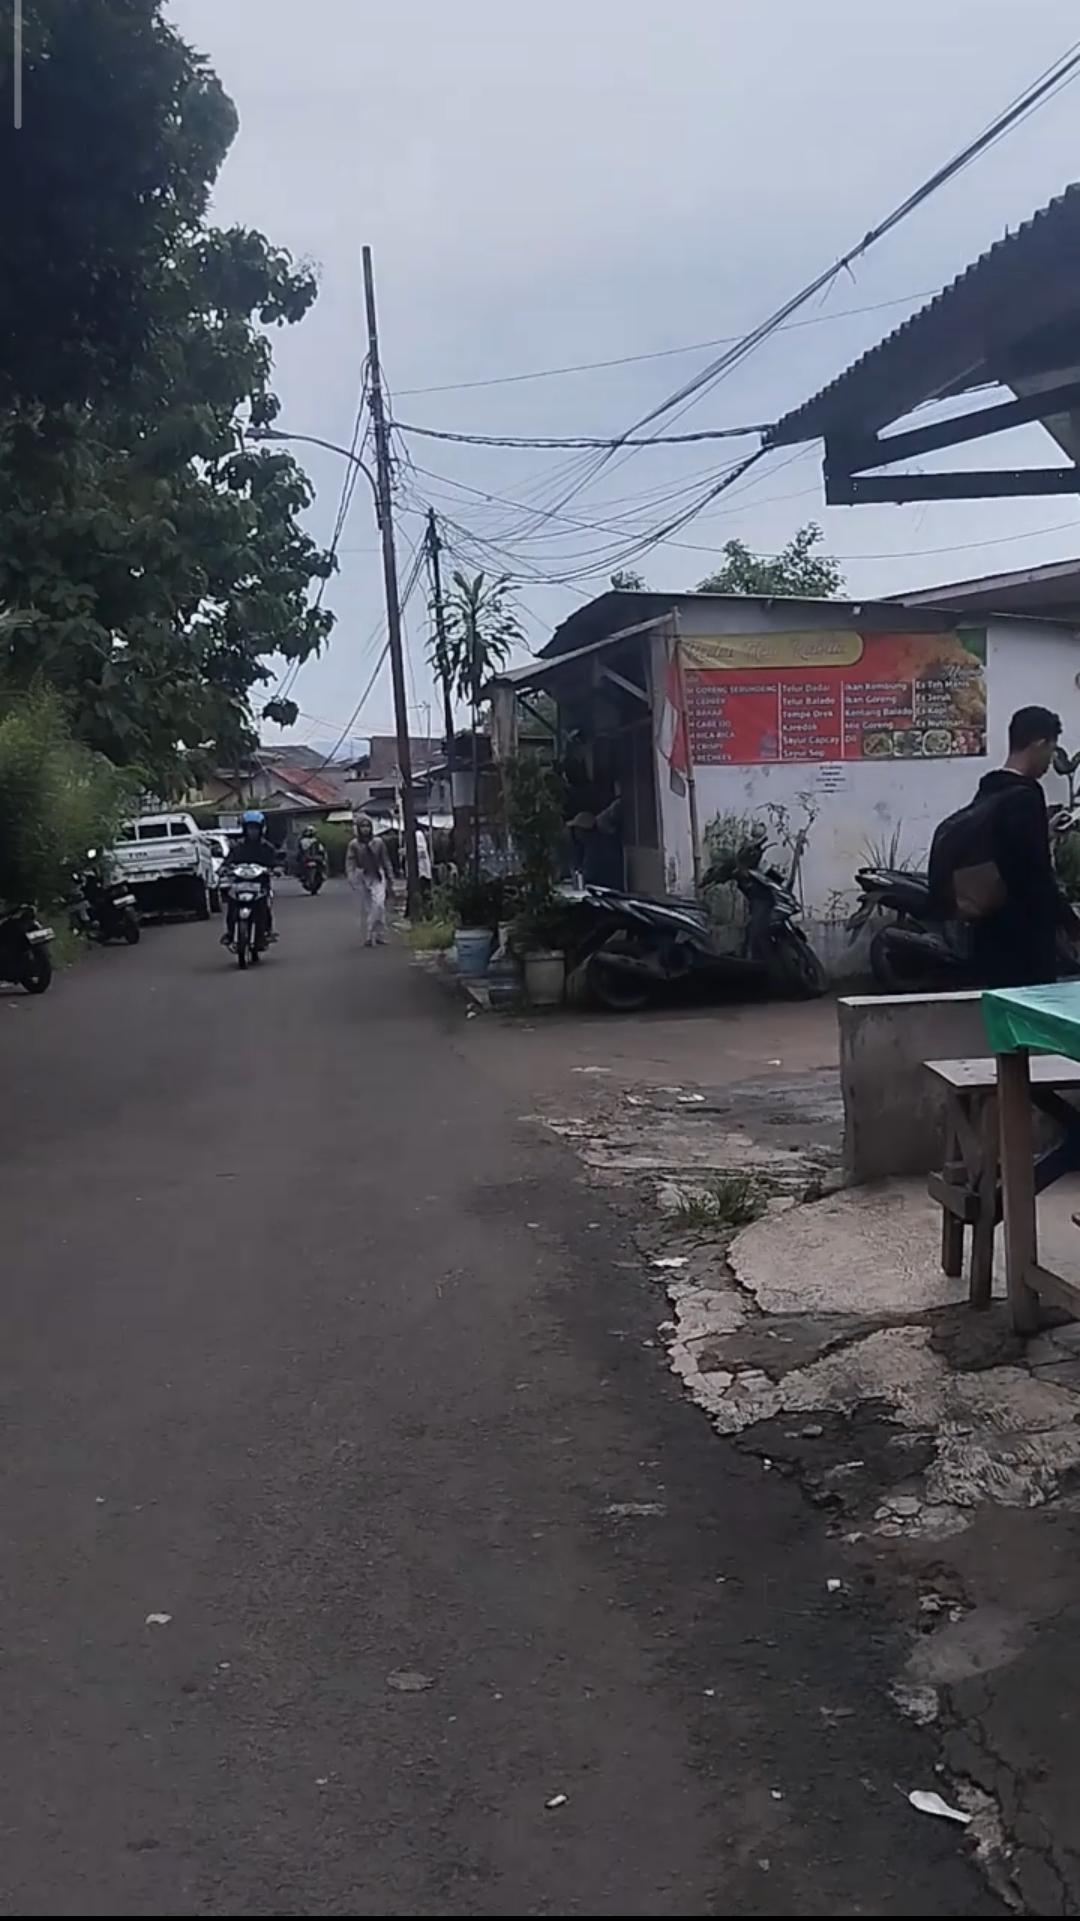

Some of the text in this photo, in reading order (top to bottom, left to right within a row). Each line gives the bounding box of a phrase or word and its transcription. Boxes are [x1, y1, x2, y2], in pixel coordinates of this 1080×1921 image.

[783, 684, 830, 693] Telur Dadar
[845, 682, 863, 690] Ikan
[783, 697, 835, 705] Telur Balado
[845, 695, 897, 704] Ikan Goreng
[845, 707, 913, 717] Kentang Balado
[862, 720, 894, 730] Goreng
[783, 735, 806, 745] Sayur
[783, 749, 807, 759] Sayur
